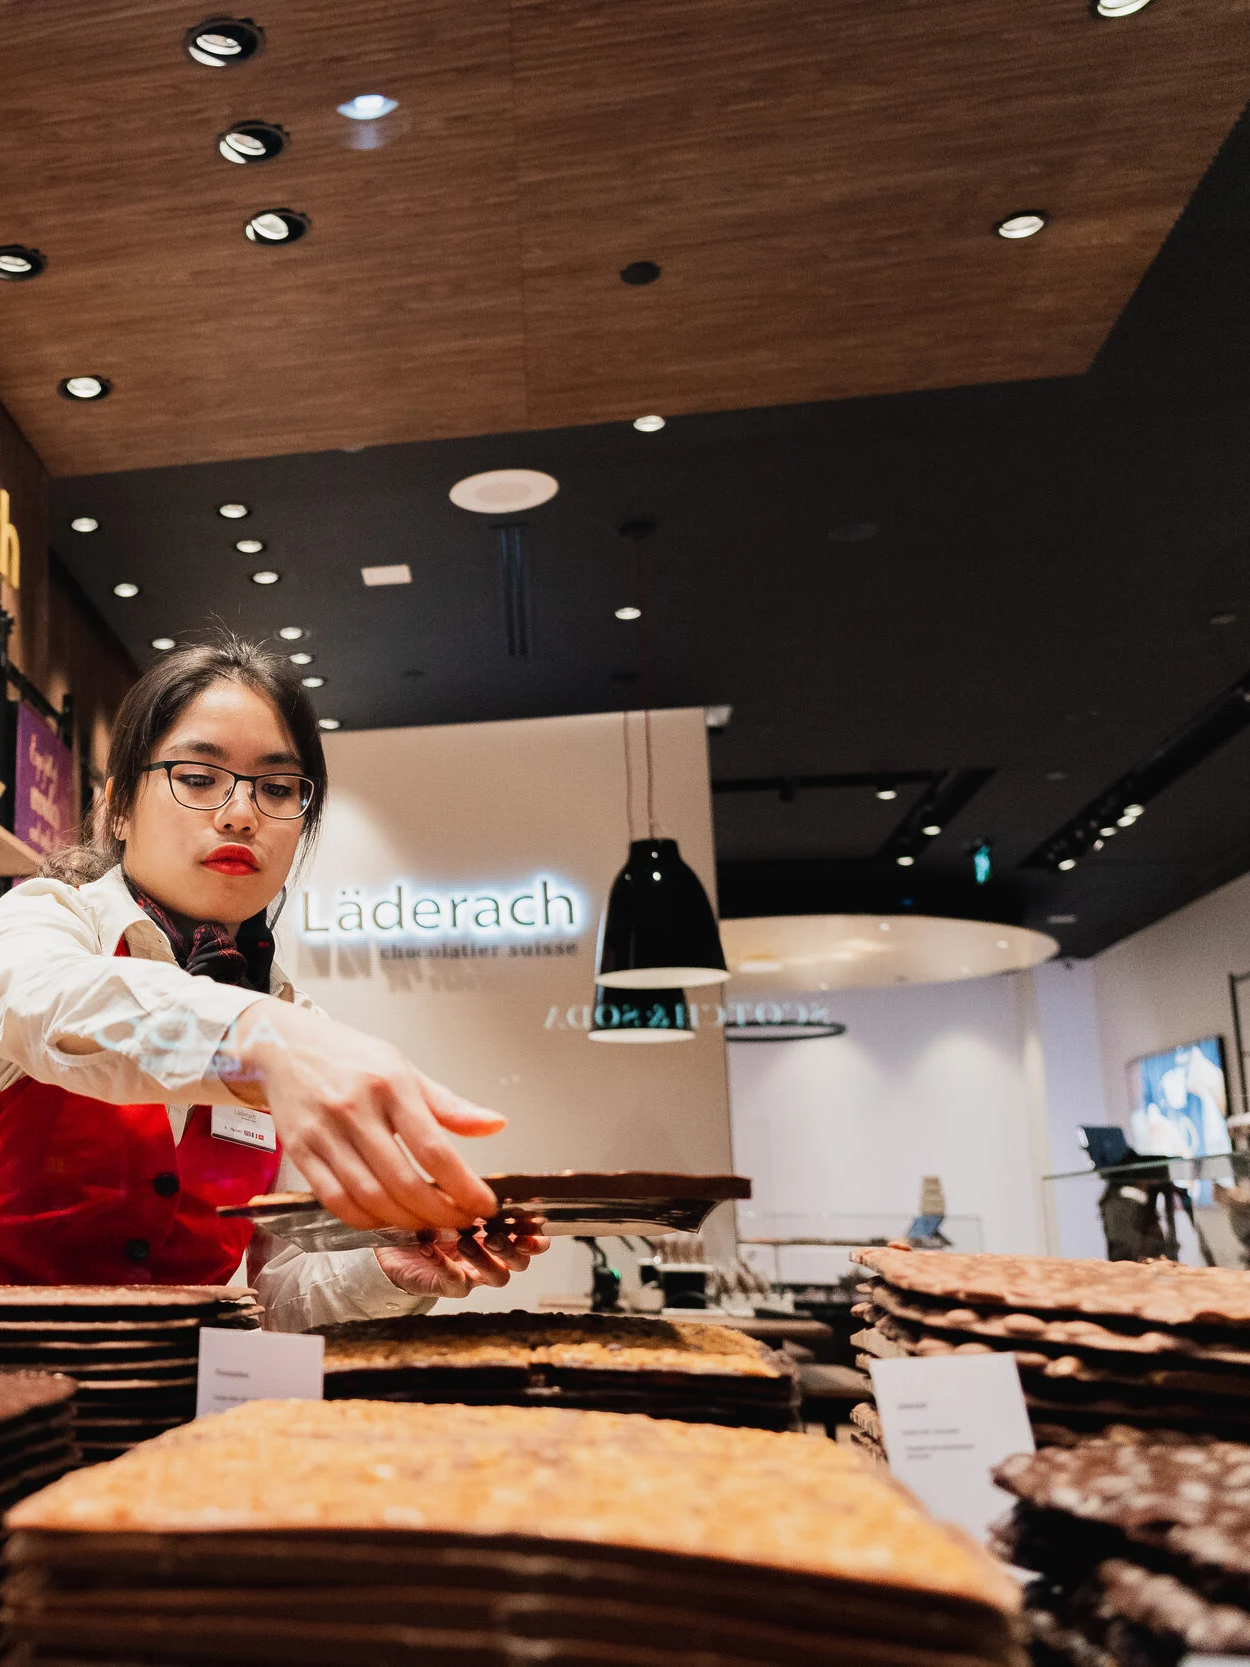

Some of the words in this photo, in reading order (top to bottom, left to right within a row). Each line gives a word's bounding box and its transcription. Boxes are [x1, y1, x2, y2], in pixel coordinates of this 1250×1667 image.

[302, 881, 575, 932] Läderach
[380, 942, 500, 961] chocolatier
[508, 941, 579, 958] suisse
